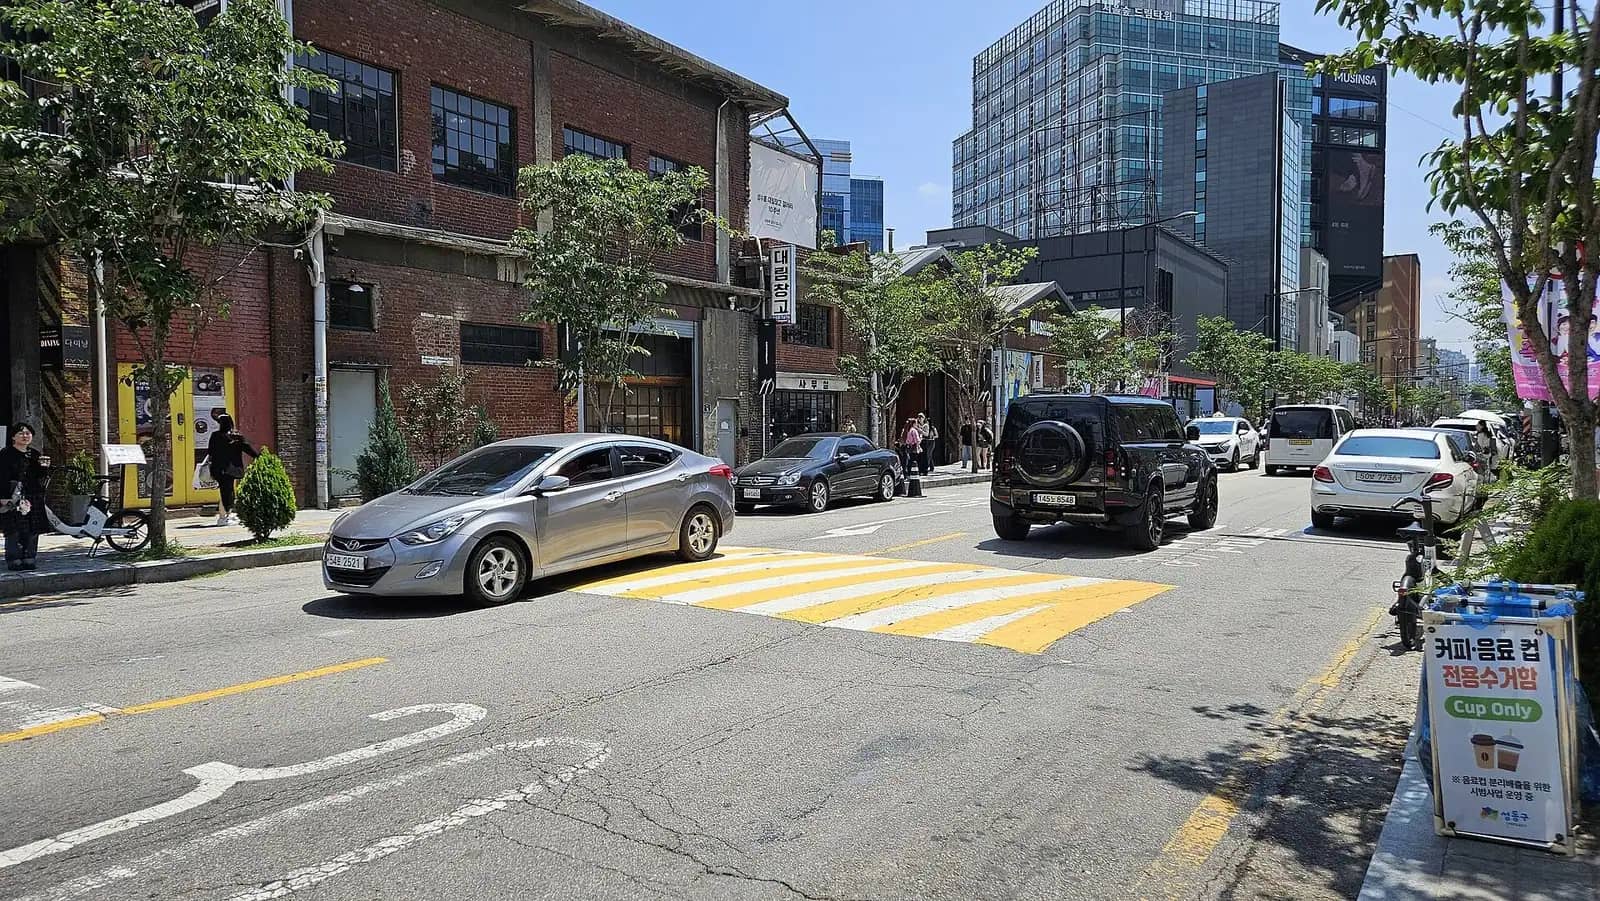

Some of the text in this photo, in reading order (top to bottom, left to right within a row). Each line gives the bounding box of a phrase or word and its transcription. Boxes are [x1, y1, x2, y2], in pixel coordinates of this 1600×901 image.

[1334, 71, 1377, 86] MUSINSA
[774, 249, 790, 314] 대림창고
[342, 556, 361, 569] 2521
[1520, 638, 1540, 662] 컵
[1442, 665, 1537, 690] 전용수거함
[1453, 700, 1532, 719] Cup Only
[1462, 775, 1487, 787] 음료컵
[1489, 778, 1531, 791] 분리배출을
[1533, 782, 1552, 793] 위한
[1470, 787, 1535, 802] 시범사업 운영 중
[1500, 810, 1530, 823] 성동구
